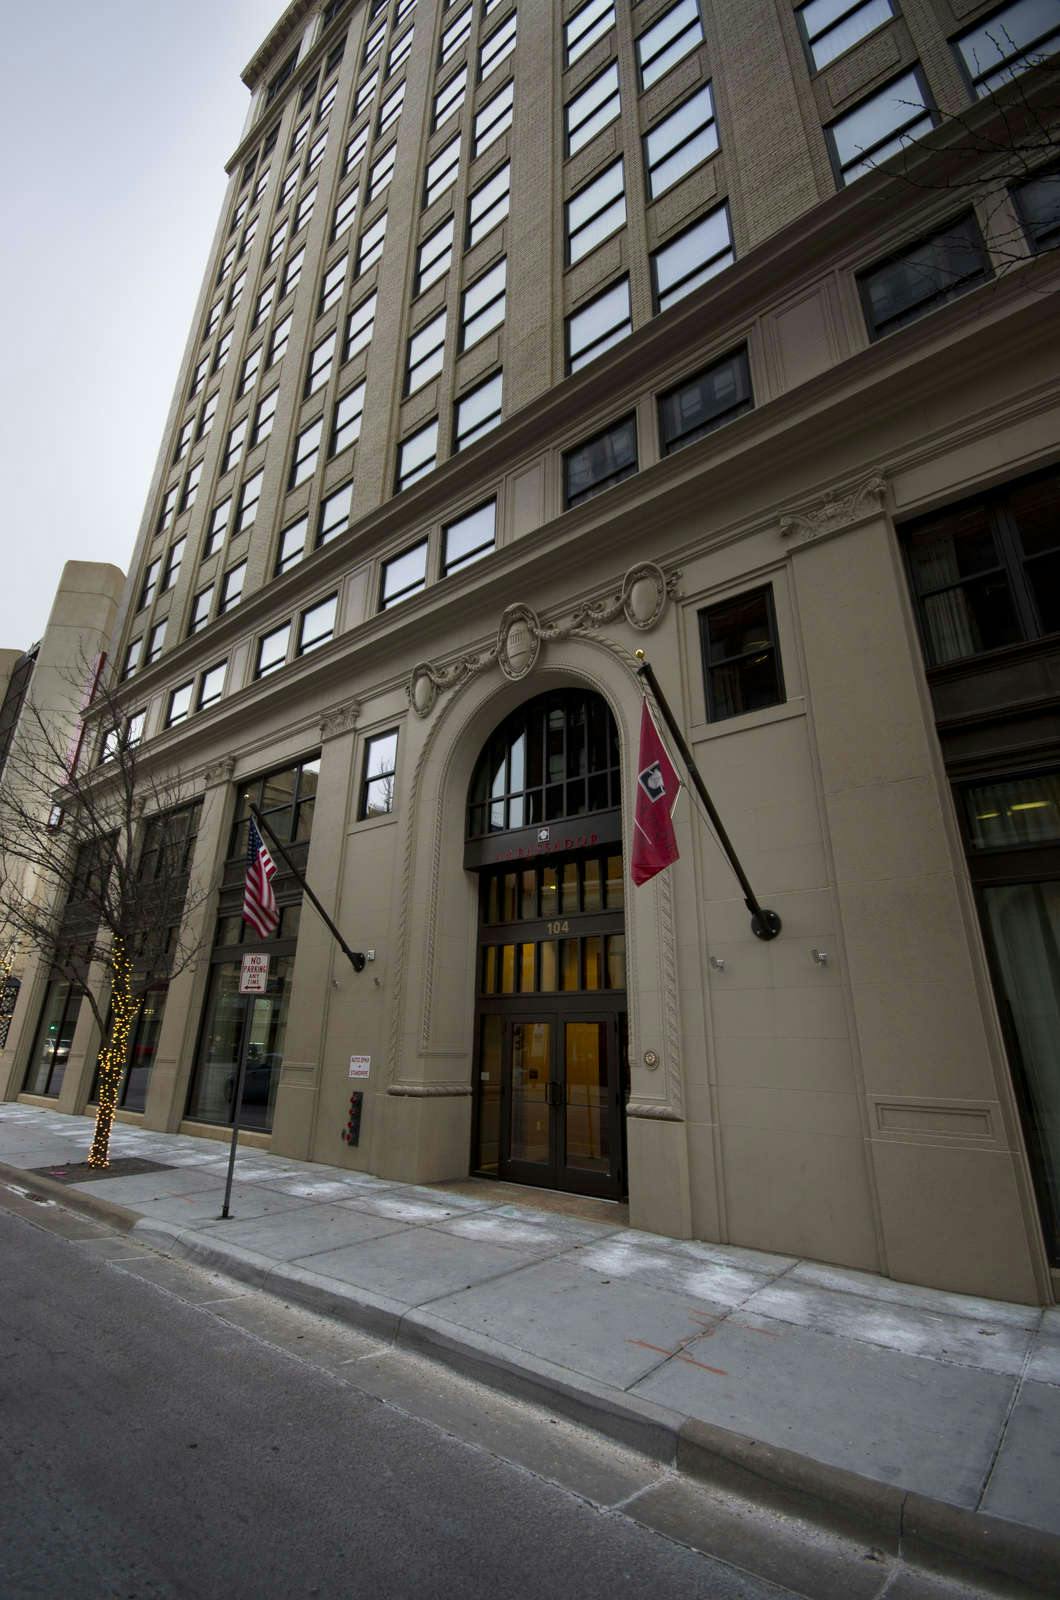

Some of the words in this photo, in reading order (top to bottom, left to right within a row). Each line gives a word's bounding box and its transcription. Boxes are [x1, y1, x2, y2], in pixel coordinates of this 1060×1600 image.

[547, 920, 570, 935] 104
[251, 956, 262, 965] NO
[243, 965, 267, 973] PARKING
